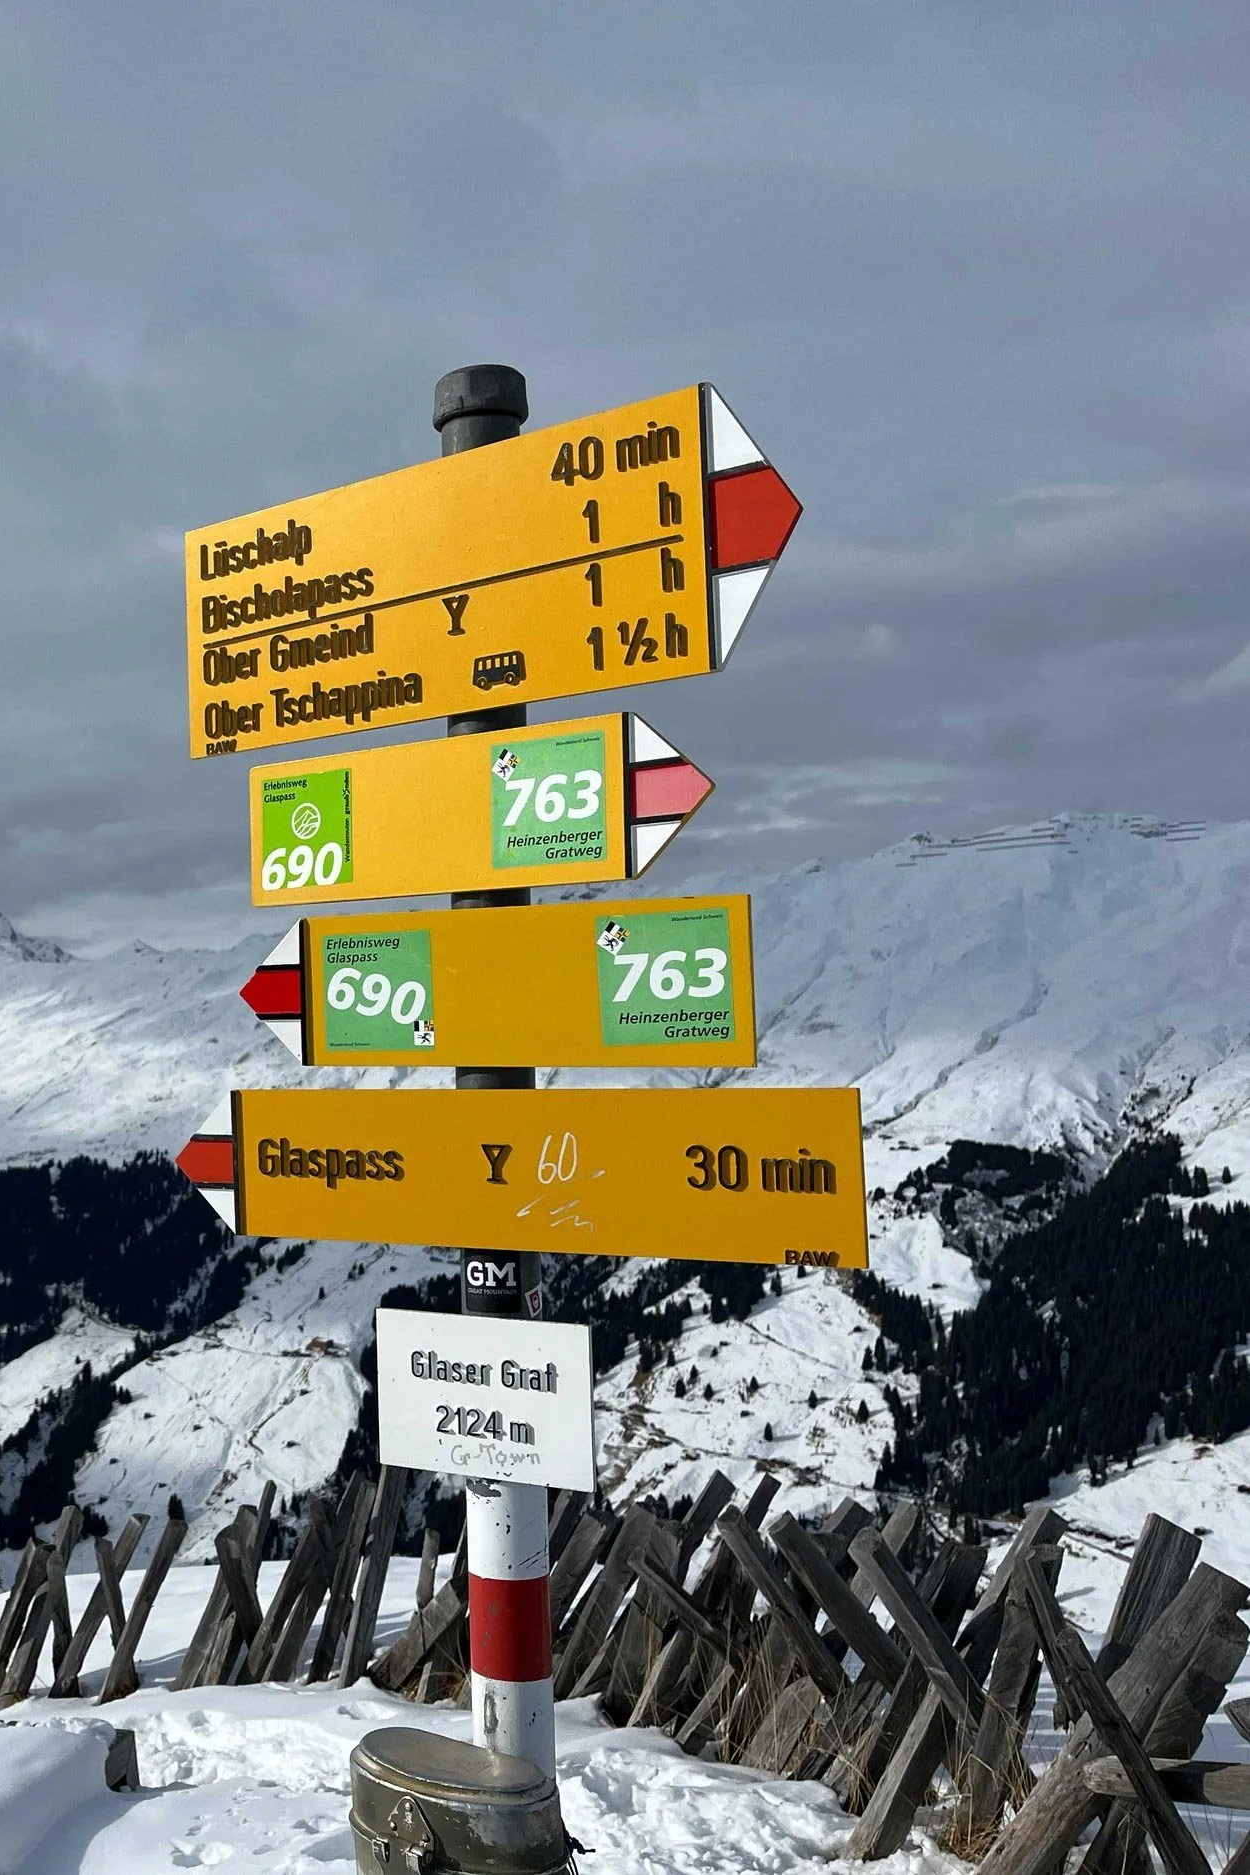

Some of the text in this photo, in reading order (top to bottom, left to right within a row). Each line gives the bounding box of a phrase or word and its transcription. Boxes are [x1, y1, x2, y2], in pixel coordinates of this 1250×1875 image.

[200, 421, 680, 580] Lüschalp 40 min
[202, 482, 682, 634] Bischolapass 1 h
[203, 547, 684, 686] Ober Gmeind 1 h
[205, 700, 264, 739] Ober
[270, 670, 423, 728] Tschappina
[665, 613, 688, 658] h
[206, 739, 237, 756] BAW
[263, 779, 308, 791] Erlebnisweg
[264, 792, 296, 803] Glaspass
[502, 769, 602, 827] 763
[507, 830, 603, 848] Heinzenberger
[545, 846, 603, 859] Gratweg
[262, 842, 343, 891] 690
[326, 937, 400, 950] Erlebnisweg
[327, 952, 378, 965] Glaspass
[612, 947, 727, 1003] 763
[327, 967, 426, 1024] 690
[619, 1009, 730, 1024] Heinzenberger
[664, 1026, 730, 1039] Gratweg
[257, 1137, 837, 1195] Glaspass 30 min
[467, 1261, 516, 1287] GM
[785, 1249, 840, 1268] BAW
[411, 1350, 559, 1394] Glaser Grat
[436, 1405, 535, 1446] 2124 m
